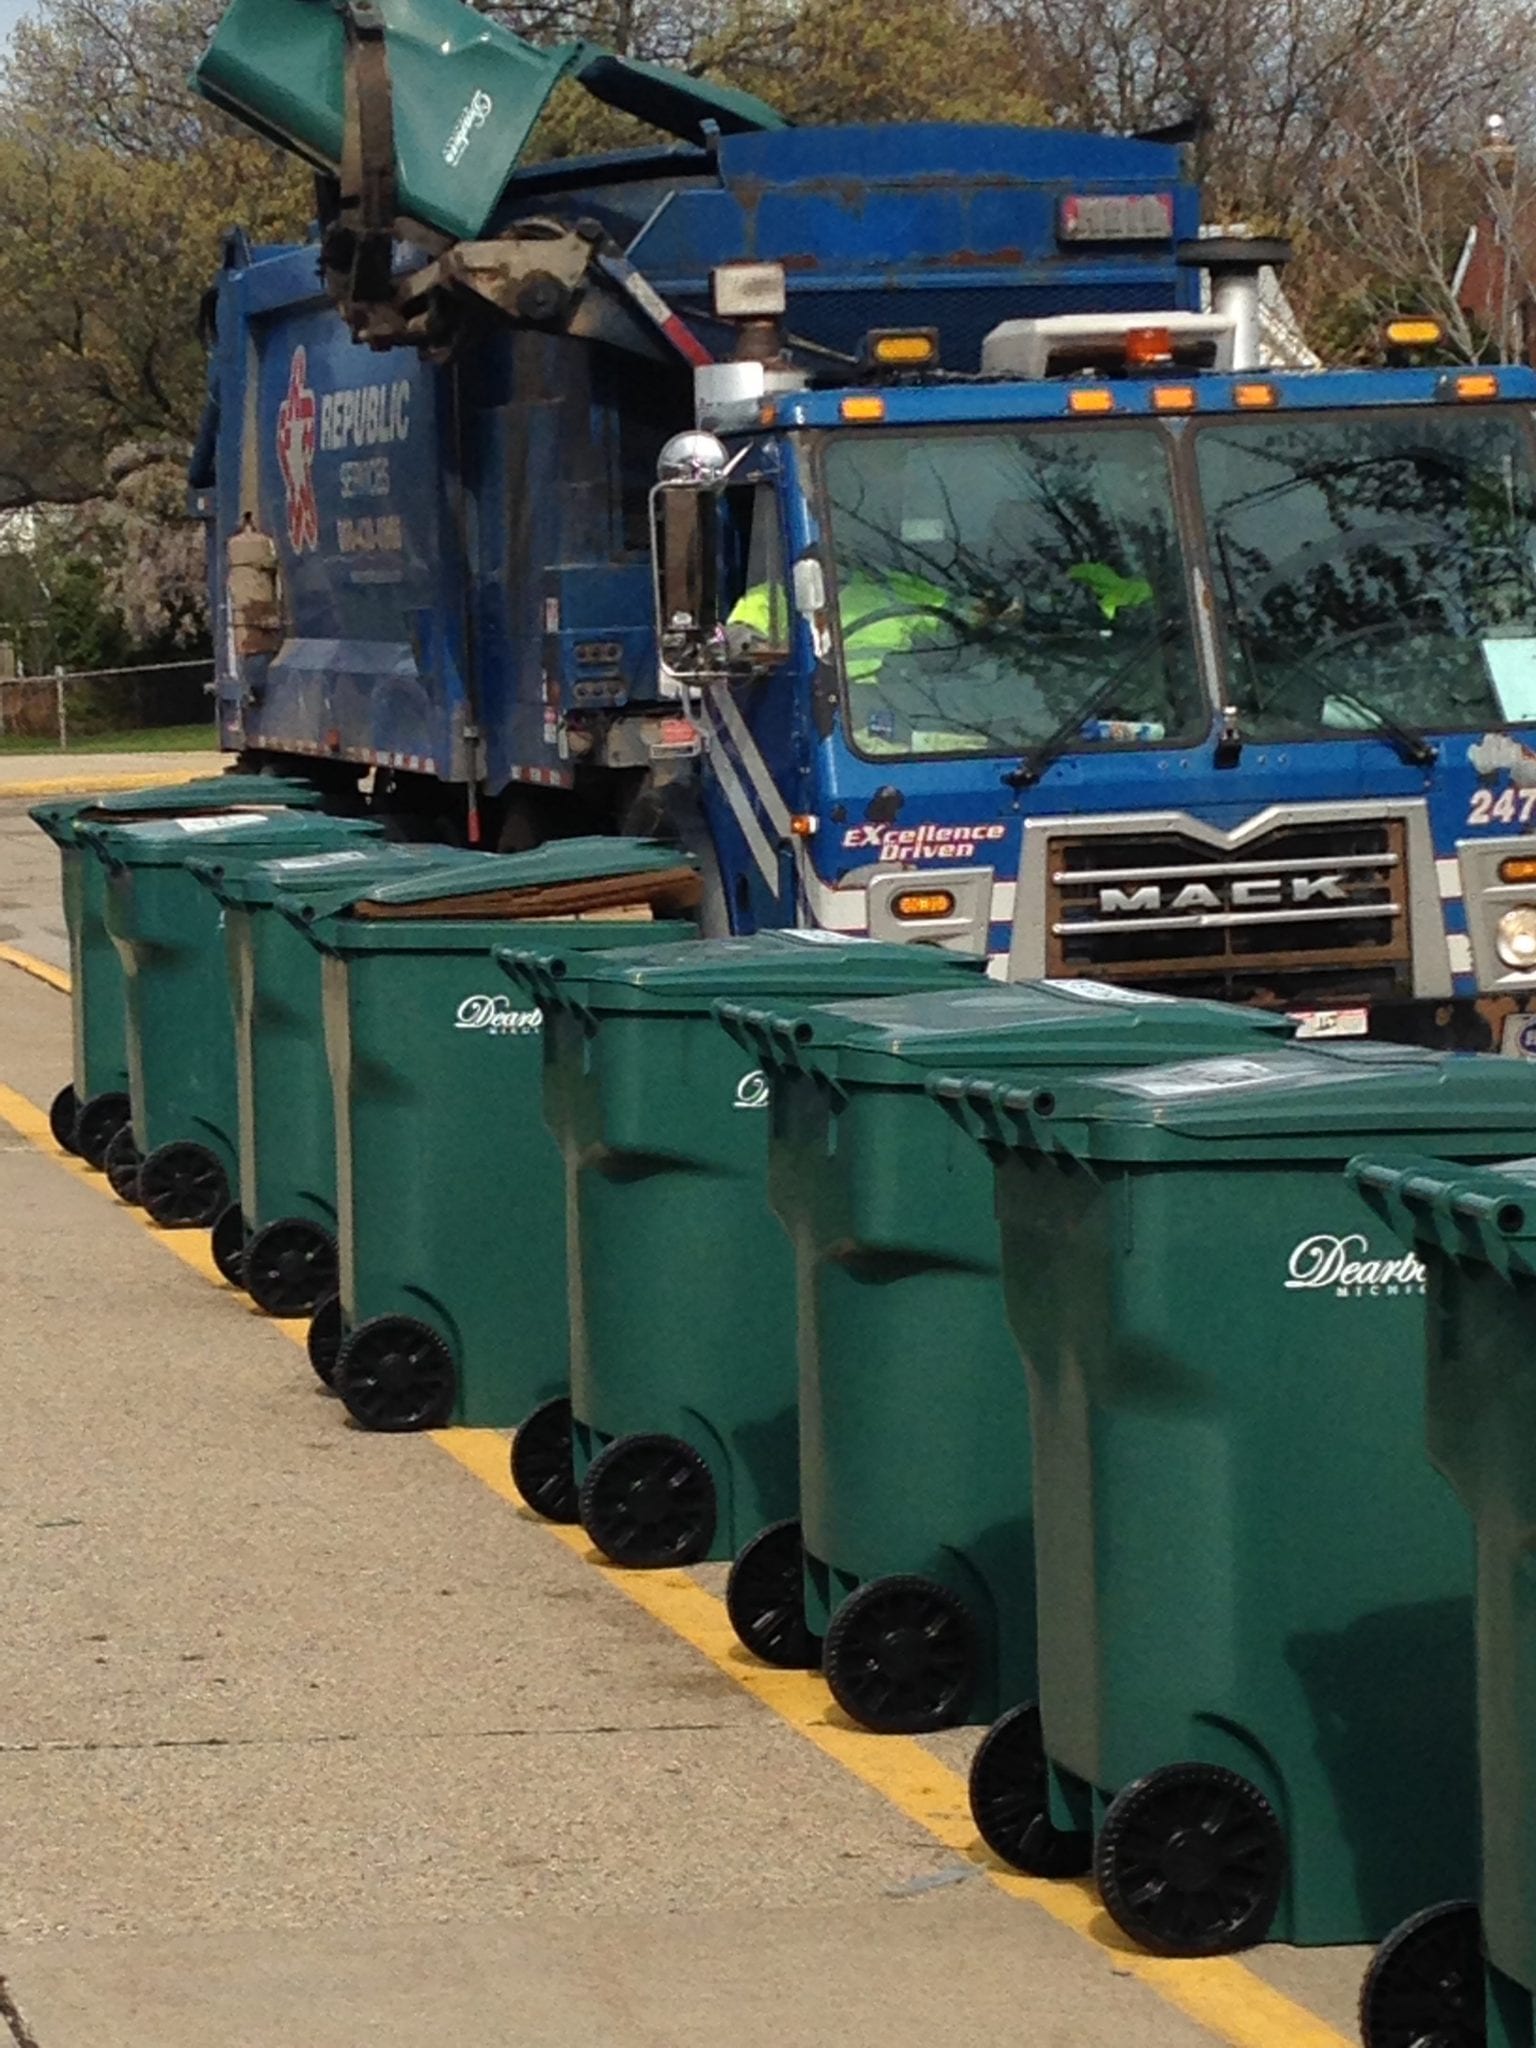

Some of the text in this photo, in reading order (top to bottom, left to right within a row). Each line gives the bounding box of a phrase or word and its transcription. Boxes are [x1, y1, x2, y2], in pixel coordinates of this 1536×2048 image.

[320, 379, 411, 450] REPUBLIC
[1466, 788, 1536, 825] 247
[1100, 874, 1346, 912] MACK
